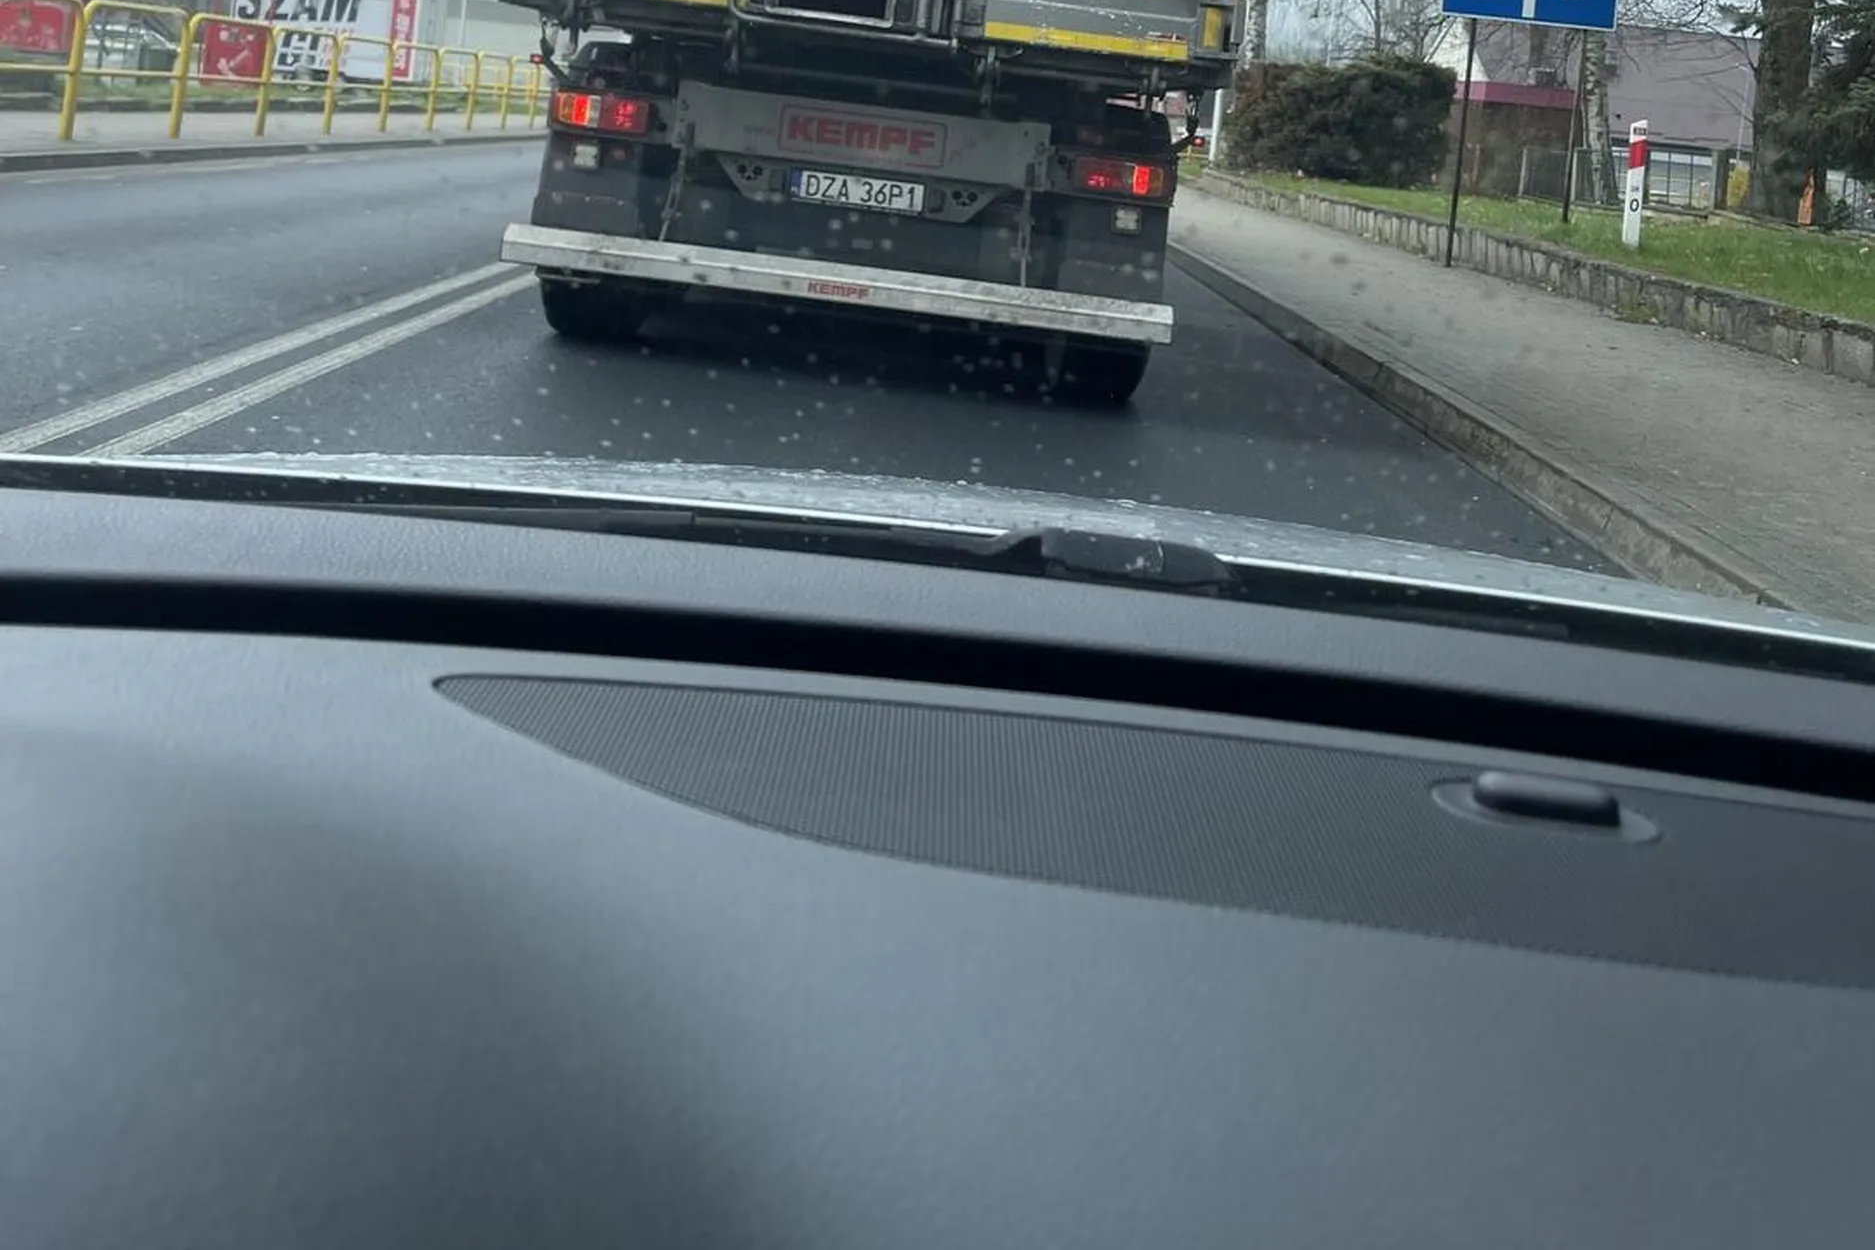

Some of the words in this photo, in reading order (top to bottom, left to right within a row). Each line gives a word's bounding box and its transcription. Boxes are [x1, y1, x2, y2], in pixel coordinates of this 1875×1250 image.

[787, 114, 936, 156] KEMPF
[804, 173, 850, 202] DZA
[859, 180, 917, 210] 36P1
[807, 281, 870, 300] KEMPF
